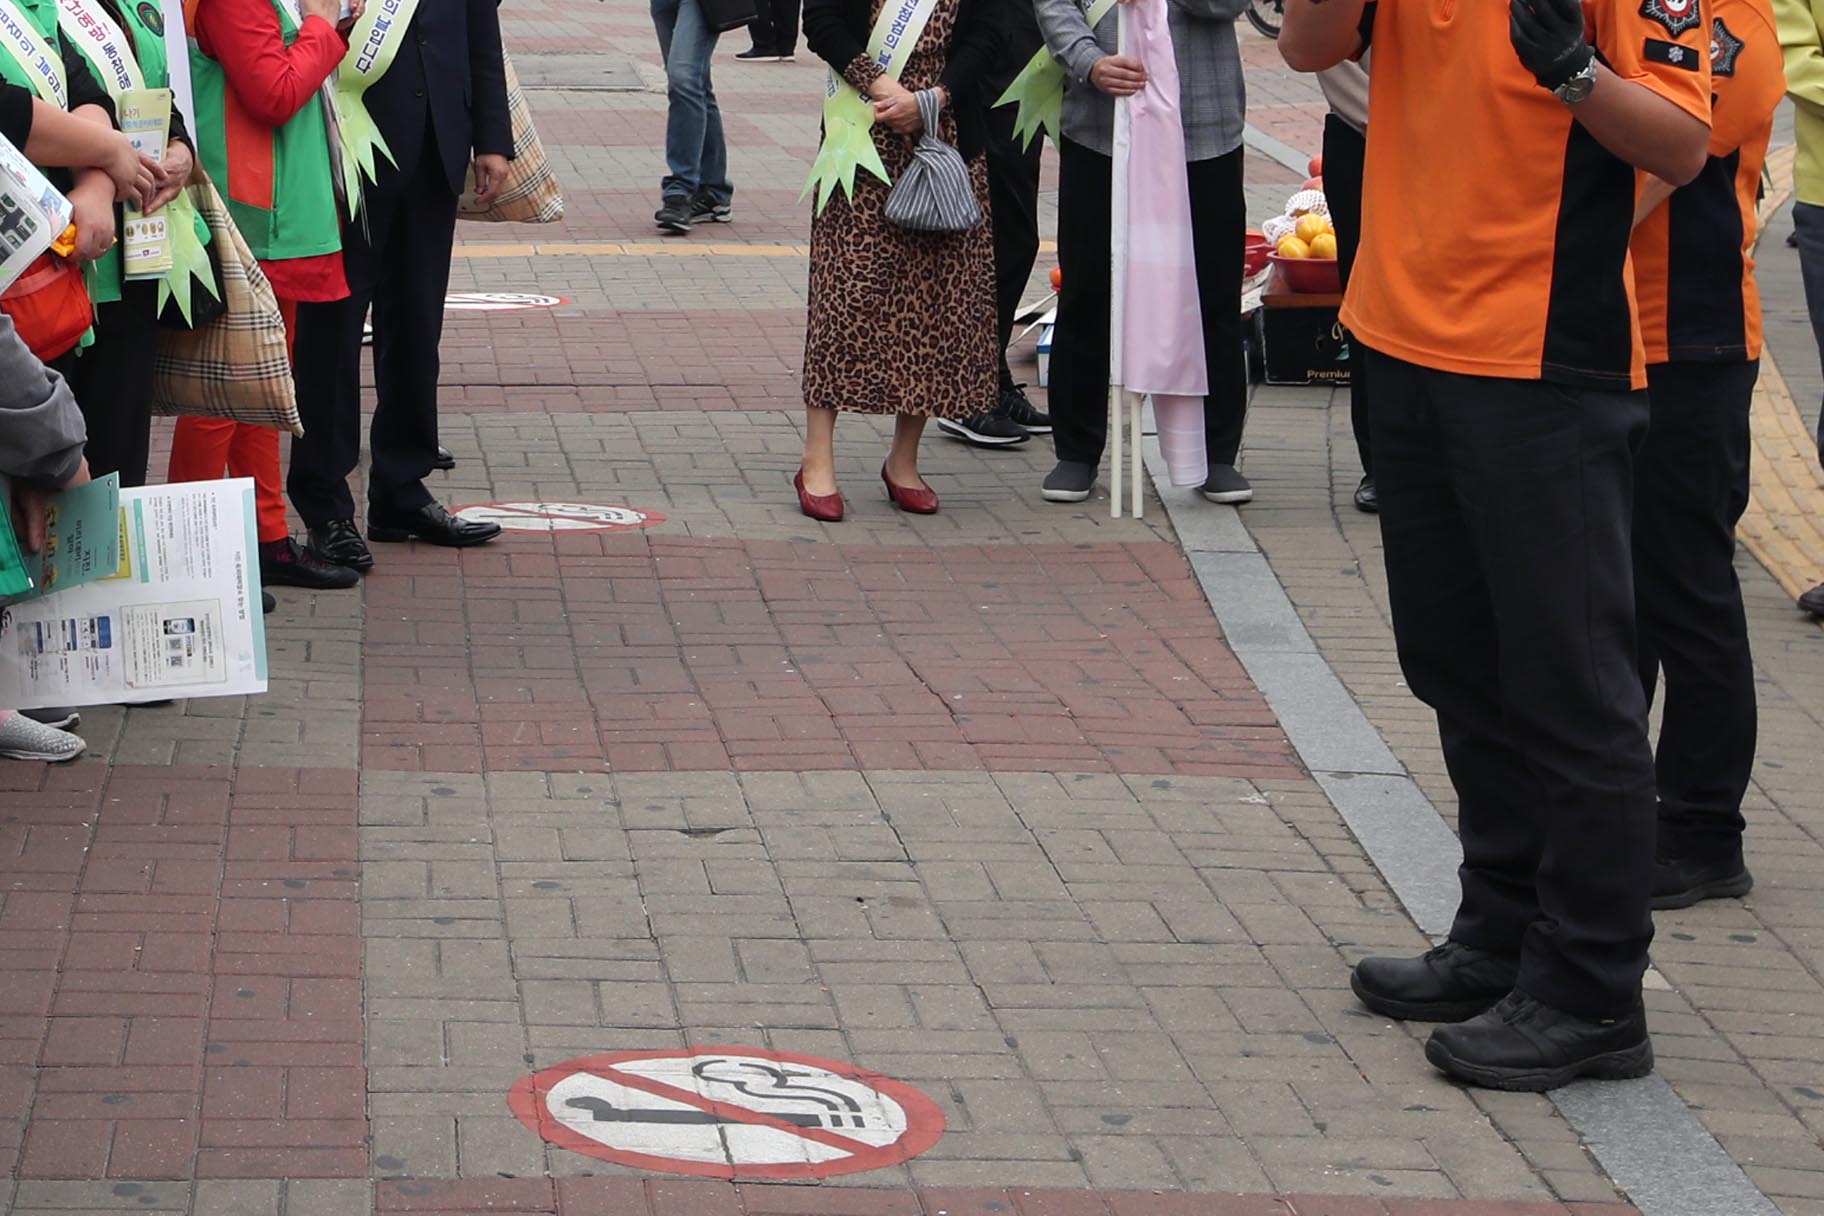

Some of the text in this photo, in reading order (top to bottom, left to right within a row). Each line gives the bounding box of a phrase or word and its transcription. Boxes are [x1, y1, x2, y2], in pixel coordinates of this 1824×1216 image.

[102, 42, 133, 92] 동참해
[354, 14, 393, 75] 날입니다
[34, 54, 68, 110] 날입니
